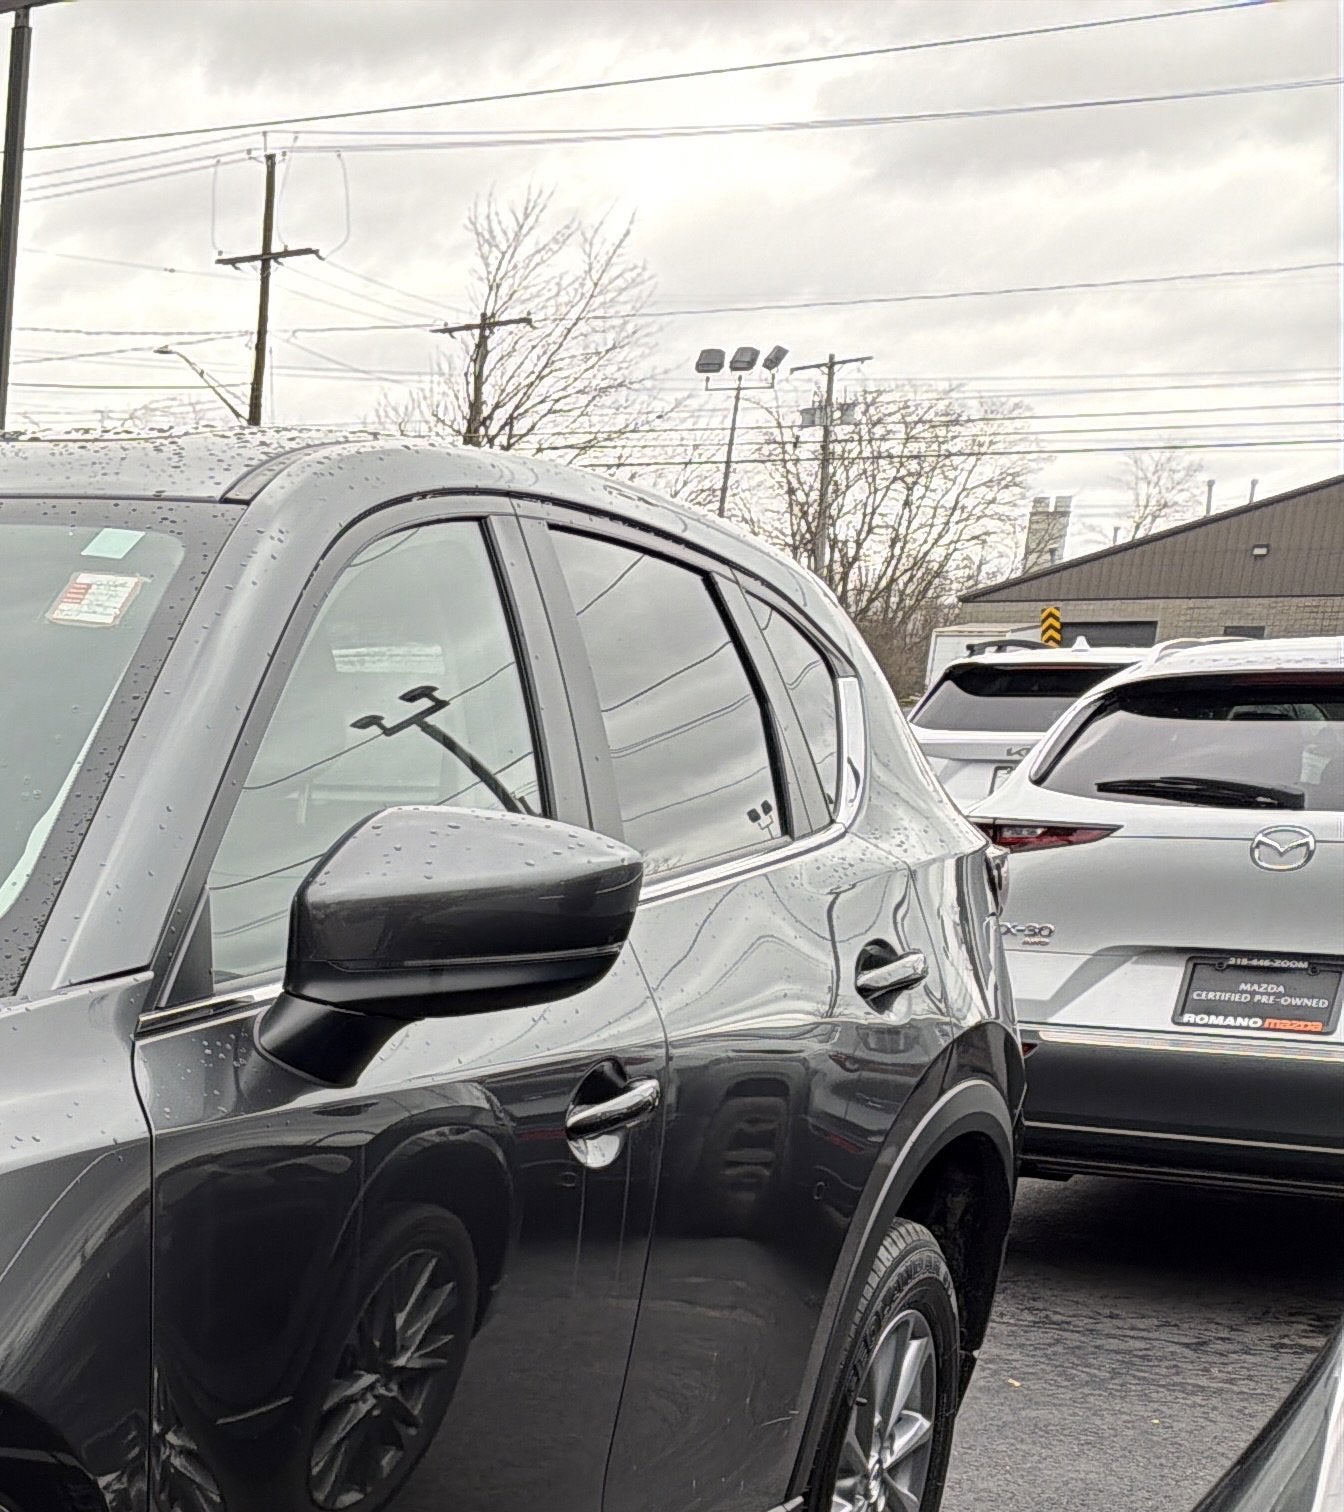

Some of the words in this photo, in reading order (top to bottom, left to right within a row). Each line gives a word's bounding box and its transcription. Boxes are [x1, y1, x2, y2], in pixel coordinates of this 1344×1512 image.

[1239, 982, 1285, 994] MAZDA
[1192, 990, 1251, 1003] CERTIFIED
[1253, 994, 1329, 1009] PRE-OWNED
[1183, 1013, 1262, 1028] ROMANO
